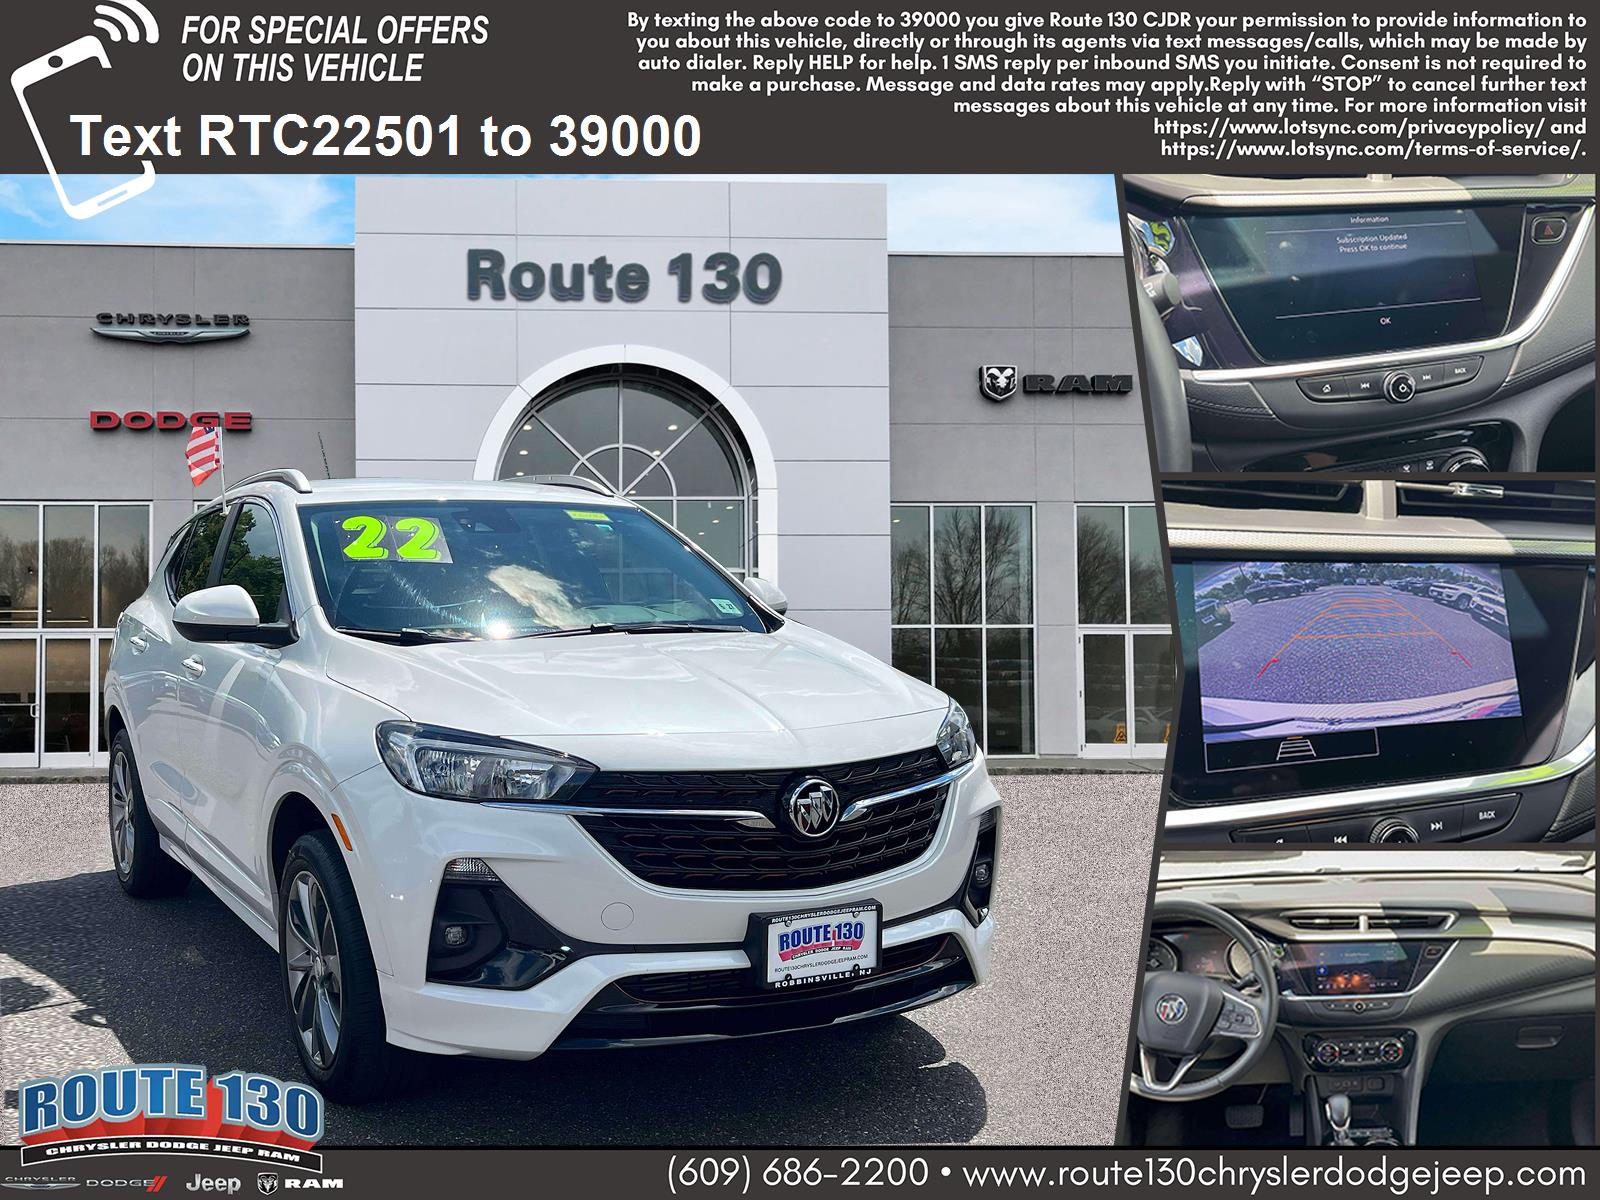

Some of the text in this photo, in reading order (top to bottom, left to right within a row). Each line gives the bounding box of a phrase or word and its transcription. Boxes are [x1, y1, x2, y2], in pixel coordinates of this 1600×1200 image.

[1350, 216, 1389, 224] Information
[1336, 233, 1408, 244] Subscription Updated
[1379, 243, 1408, 251] continue
[466, 248, 783, 305] Route 130
[95, 312, 250, 326] CHRYSLER
[1379, 317, 1391, 325] OK
[1023, 374, 1133, 393] RAM
[89, 411, 253, 431] DODGE
[341, 515, 441, 560] 22
[1478, 809, 1496, 820] BACK
[779, 922, 865, 952] ROUTE 130
[775, 968, 872, 989] ROBBINSVILLE, NJ
